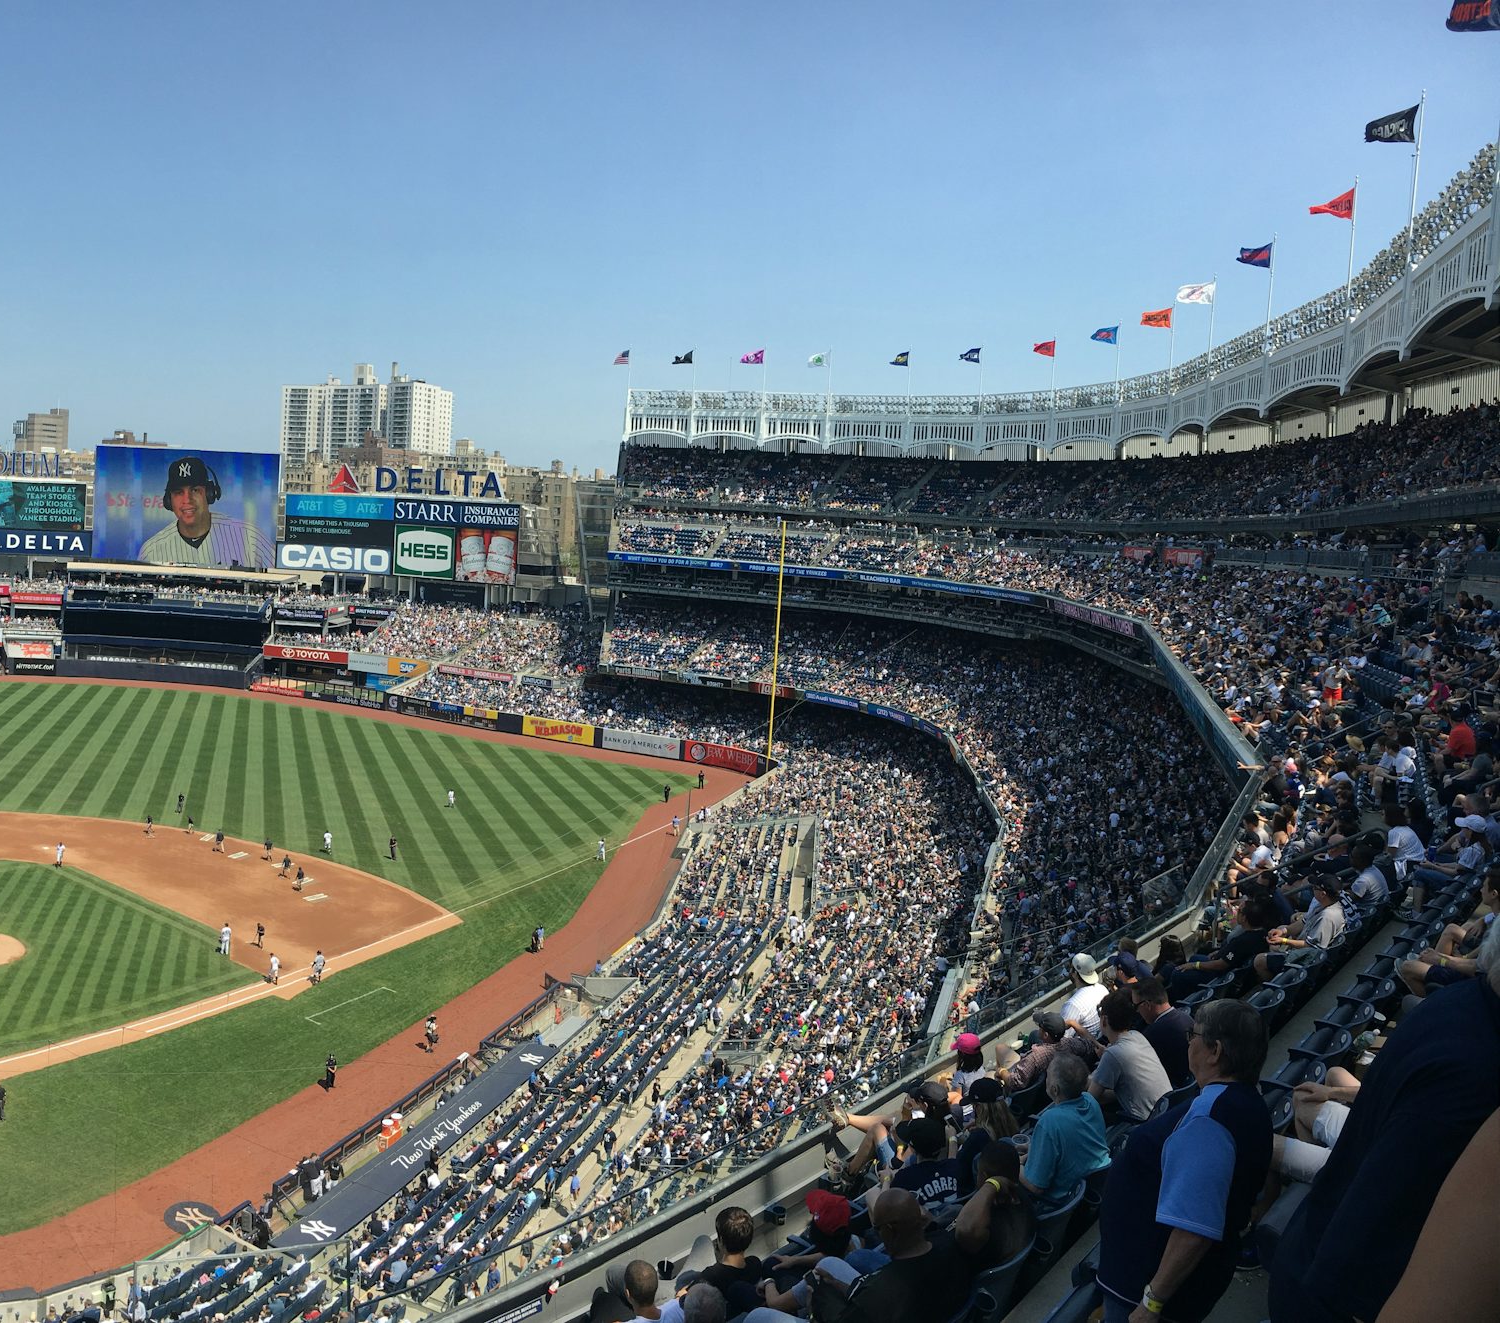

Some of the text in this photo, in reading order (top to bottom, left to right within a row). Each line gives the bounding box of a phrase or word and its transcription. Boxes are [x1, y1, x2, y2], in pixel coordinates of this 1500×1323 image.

[375, 467, 504, 498] DELTA
[24, 507, 77, 515] THROUGHOUT
[297, 500, 323, 511] AT&T
[356, 502, 384, 514] AT&T
[395, 501, 457, 522] STARR
[465, 506, 519, 517] INSURANCE
[464, 515, 519, 525] COMPANIES
[6, 533, 85, 551] DELTA
[400, 542, 448, 560] HESS
[281, 544, 389, 572] CASIO
[860, 575, 889, 583] BLEACHERS
[295, 650, 330, 660] TOYOTA
[400, 663, 414, 672] SAP
[604, 736, 621, 744] BANK
[632, 739, 662, 750] AMERICA
[391, 1100, 483, 1169] New York Yankees
[916, 1176, 958, 1201] TORRES
